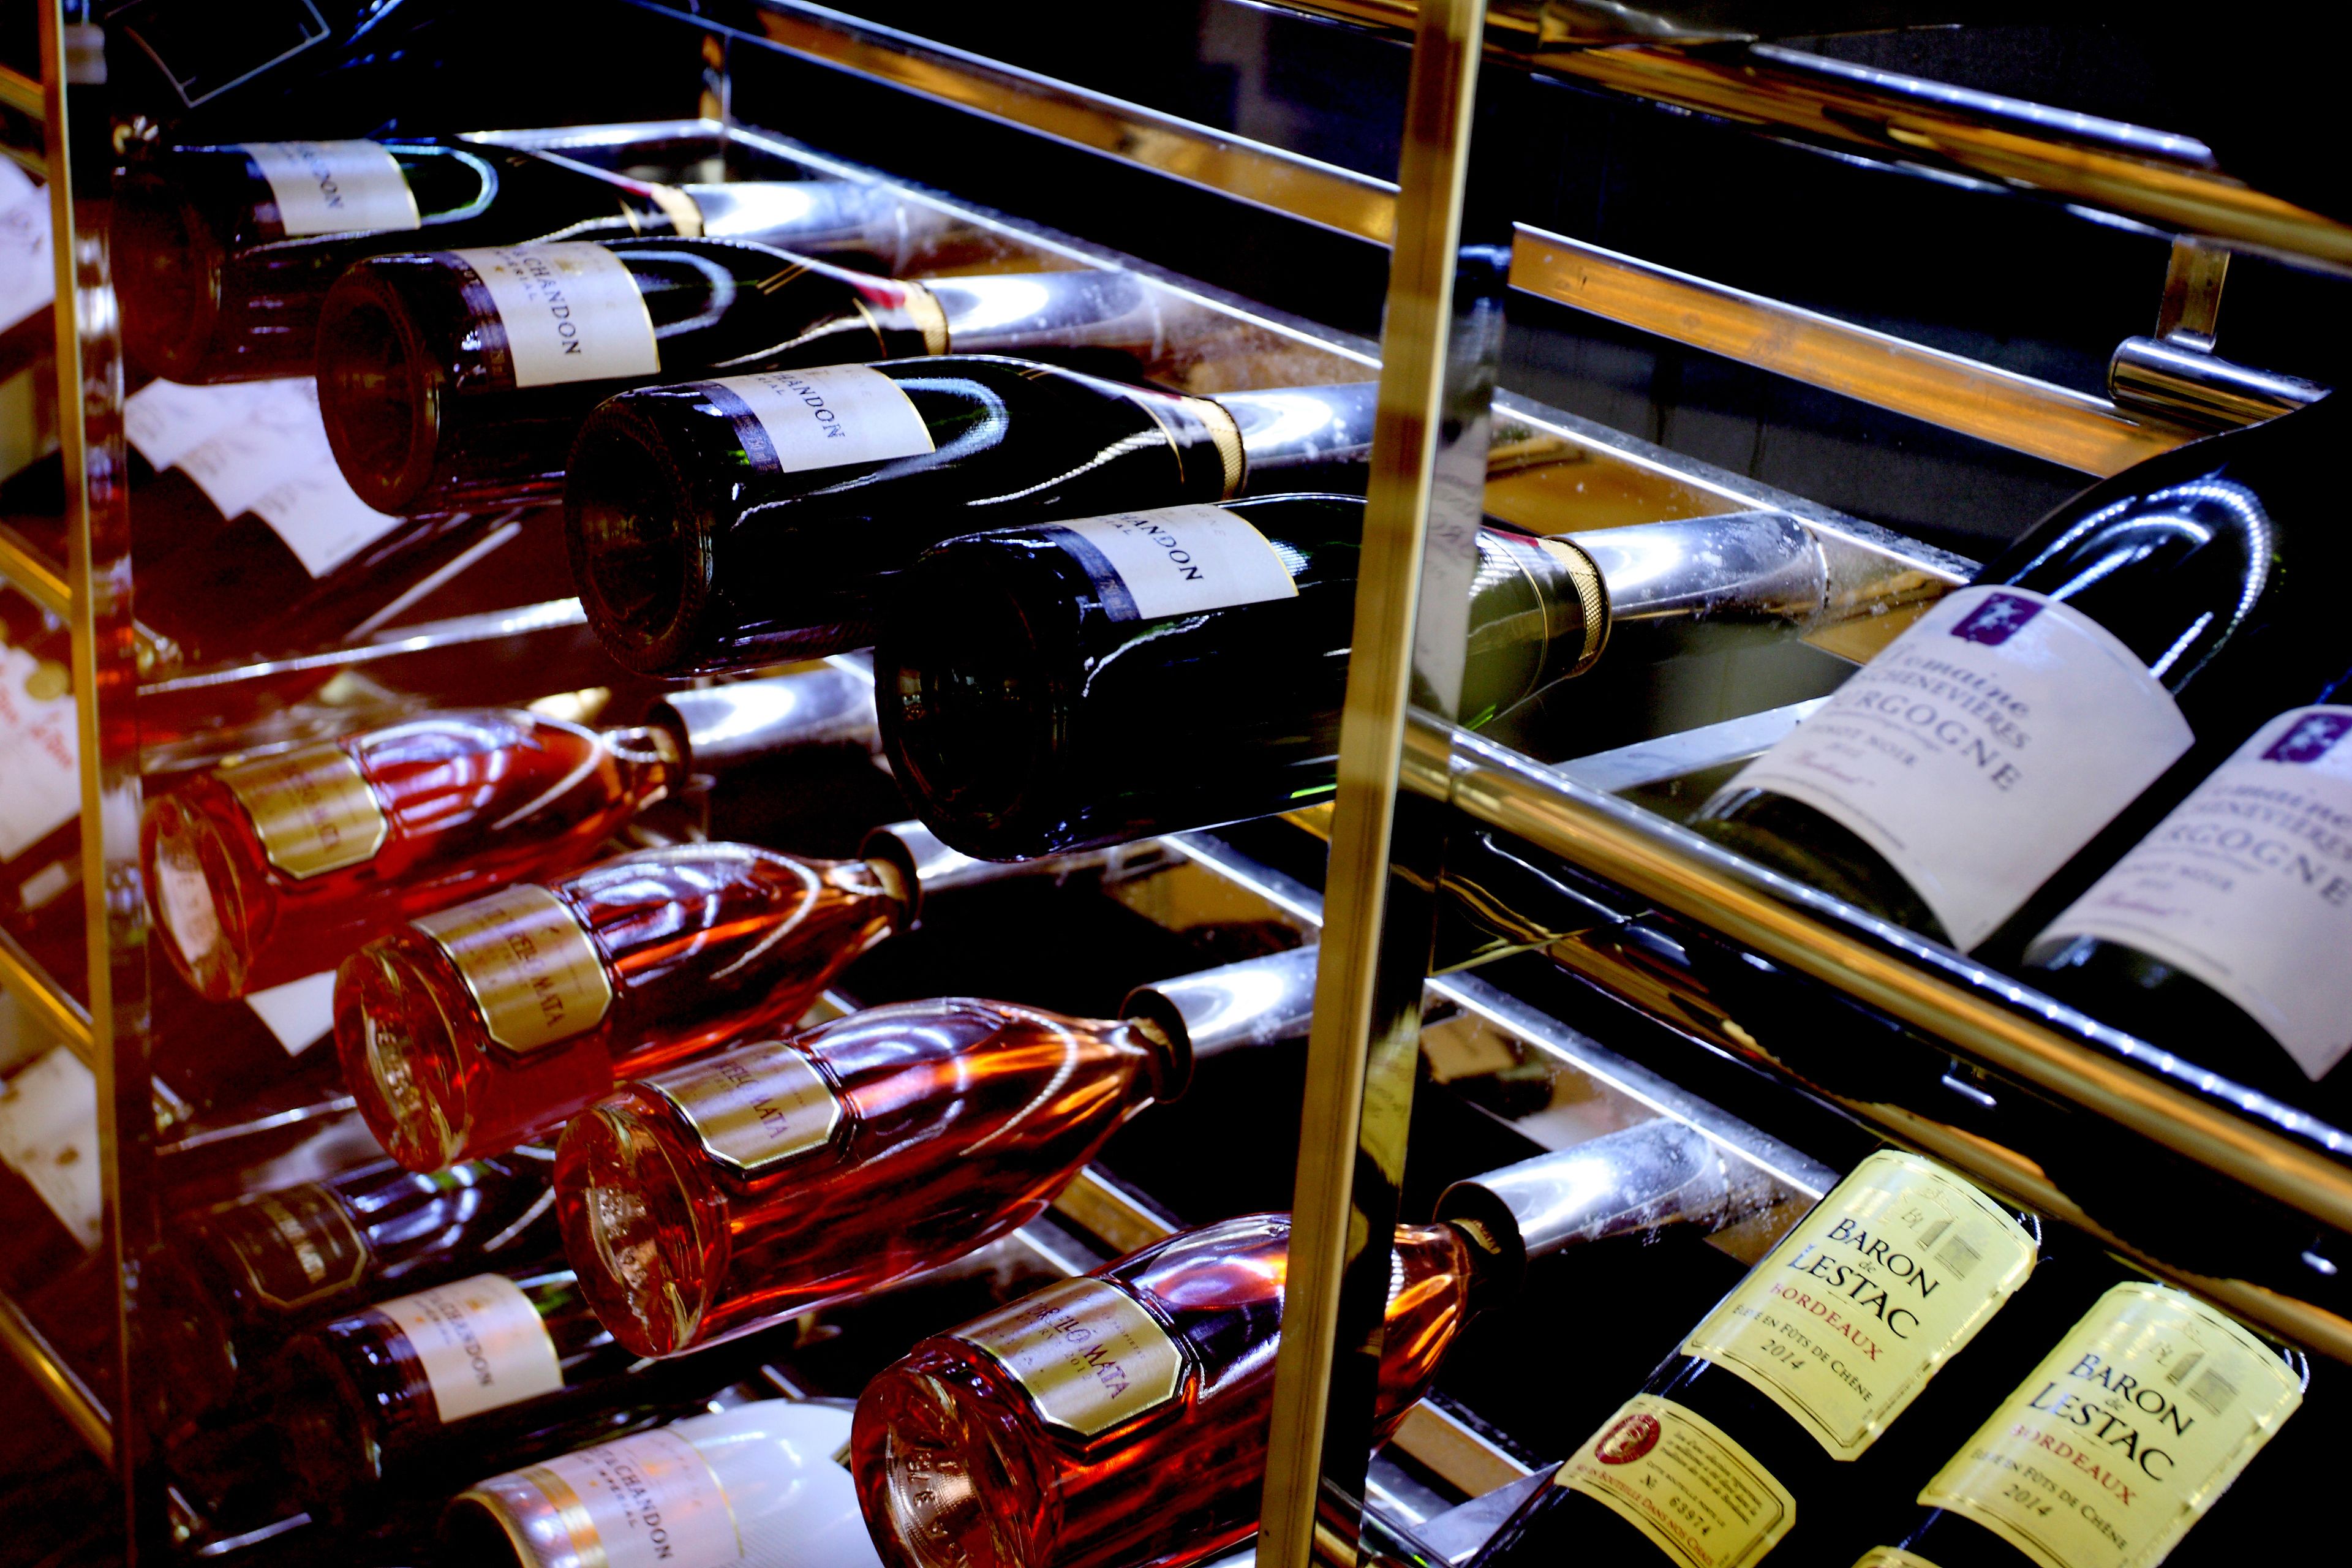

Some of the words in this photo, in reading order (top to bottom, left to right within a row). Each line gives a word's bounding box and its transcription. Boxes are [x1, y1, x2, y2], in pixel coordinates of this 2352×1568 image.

[524, 257, 581, 355] CHANDON
[1788, 1244, 1919, 1339] LESTAC
[1827, 1218, 1941, 1298] BARON
[1858, 1260, 1877, 1274] de
[1760, 1338, 1806, 1370] 2014
[1770, 1283, 1883, 1361] BORDEAUX
[1811, 1345, 1830, 1363] DE
[1079, 1344, 1131, 1400] MATA
[2068, 1353, 2195, 1438] BARON
[2011, 1425, 2137, 1506] BORDEAUX
[2027, 1382, 2174, 1482] LESTAC
[614, 1464, 674, 1559] CHANDON
[2002, 1483, 2053, 1517] 2014
